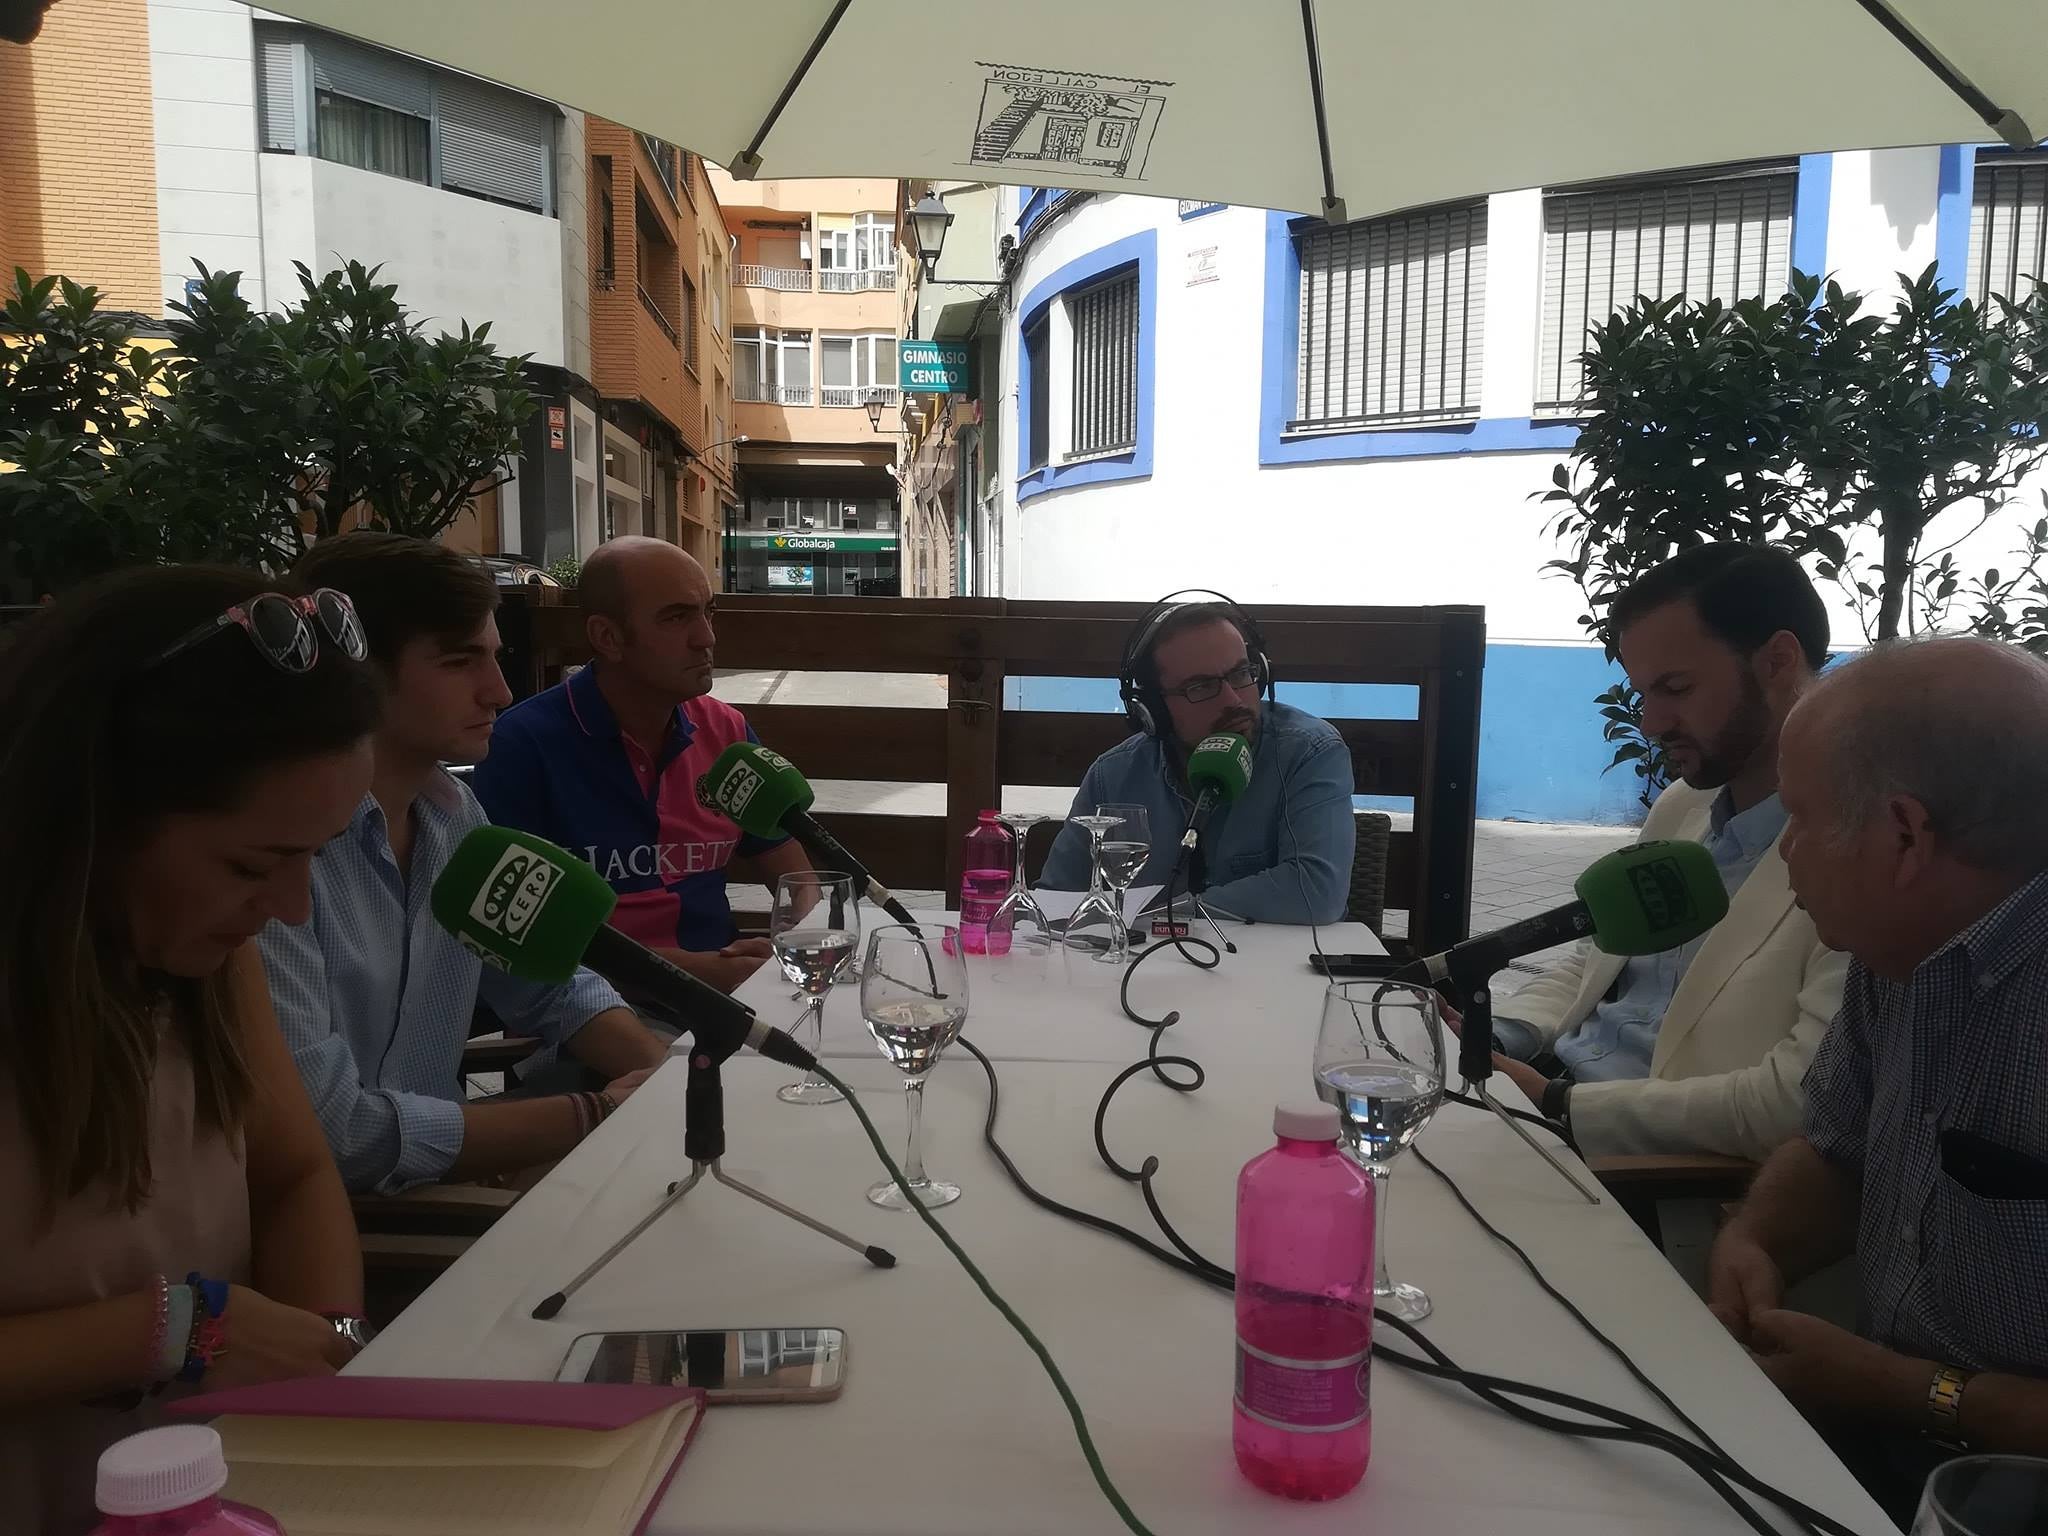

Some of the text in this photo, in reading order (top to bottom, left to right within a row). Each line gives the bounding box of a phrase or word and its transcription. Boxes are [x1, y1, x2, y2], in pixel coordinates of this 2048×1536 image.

[903, 350, 967, 364] GIMNASIO
[910, 369, 958, 384] CENTRO
[787, 538, 836, 551] Globalcaja
[721, 769, 746, 802] ONDA
[733, 779, 754, 808] CERO
[485, 859, 526, 915] ONDA
[509, 871, 546, 923] CERO
